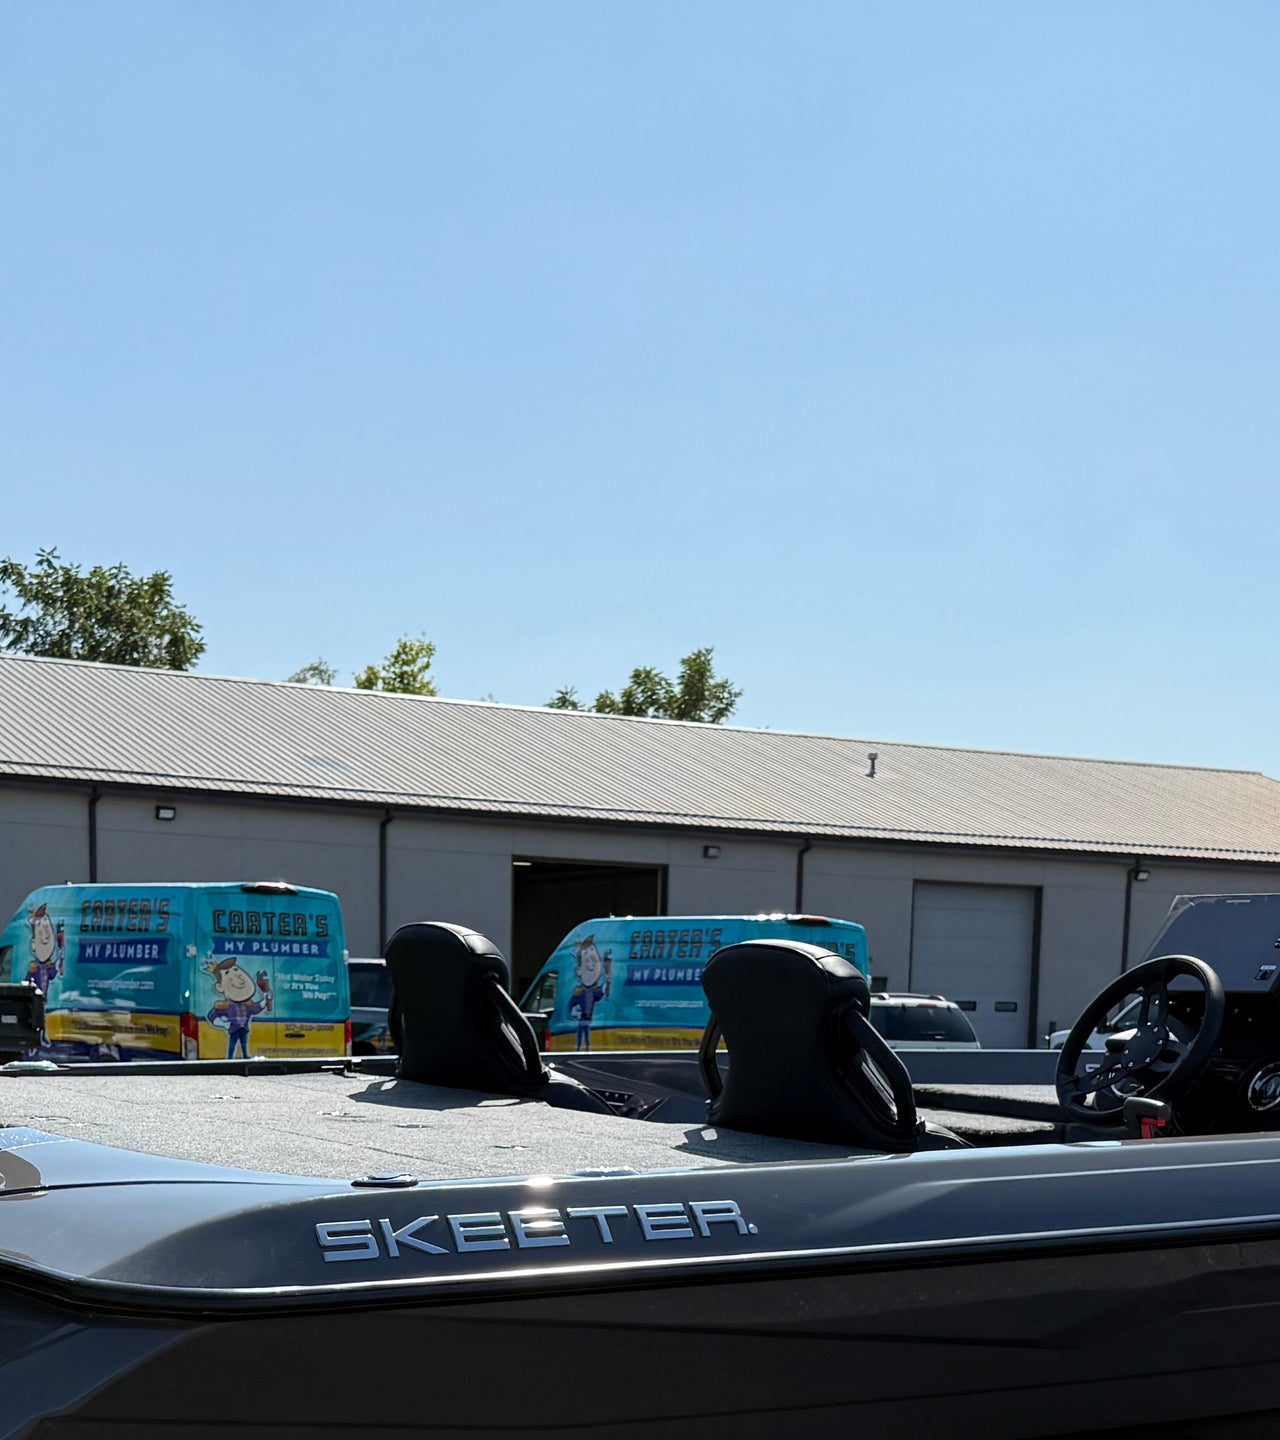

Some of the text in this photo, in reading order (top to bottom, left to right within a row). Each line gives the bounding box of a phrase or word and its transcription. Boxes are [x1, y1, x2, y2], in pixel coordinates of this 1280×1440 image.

[80, 898, 170, 932] CARTER'S
[213, 910, 329, 937] CARTER'S
[85, 943, 159, 959] MY PLUMBER
[224, 941, 320, 955] MY PLUMBER
[629, 927, 723, 959] CARTER'S
[633, 967, 702, 981] MY PLUMBE
[315, 1200, 750, 1262] SKEETER
